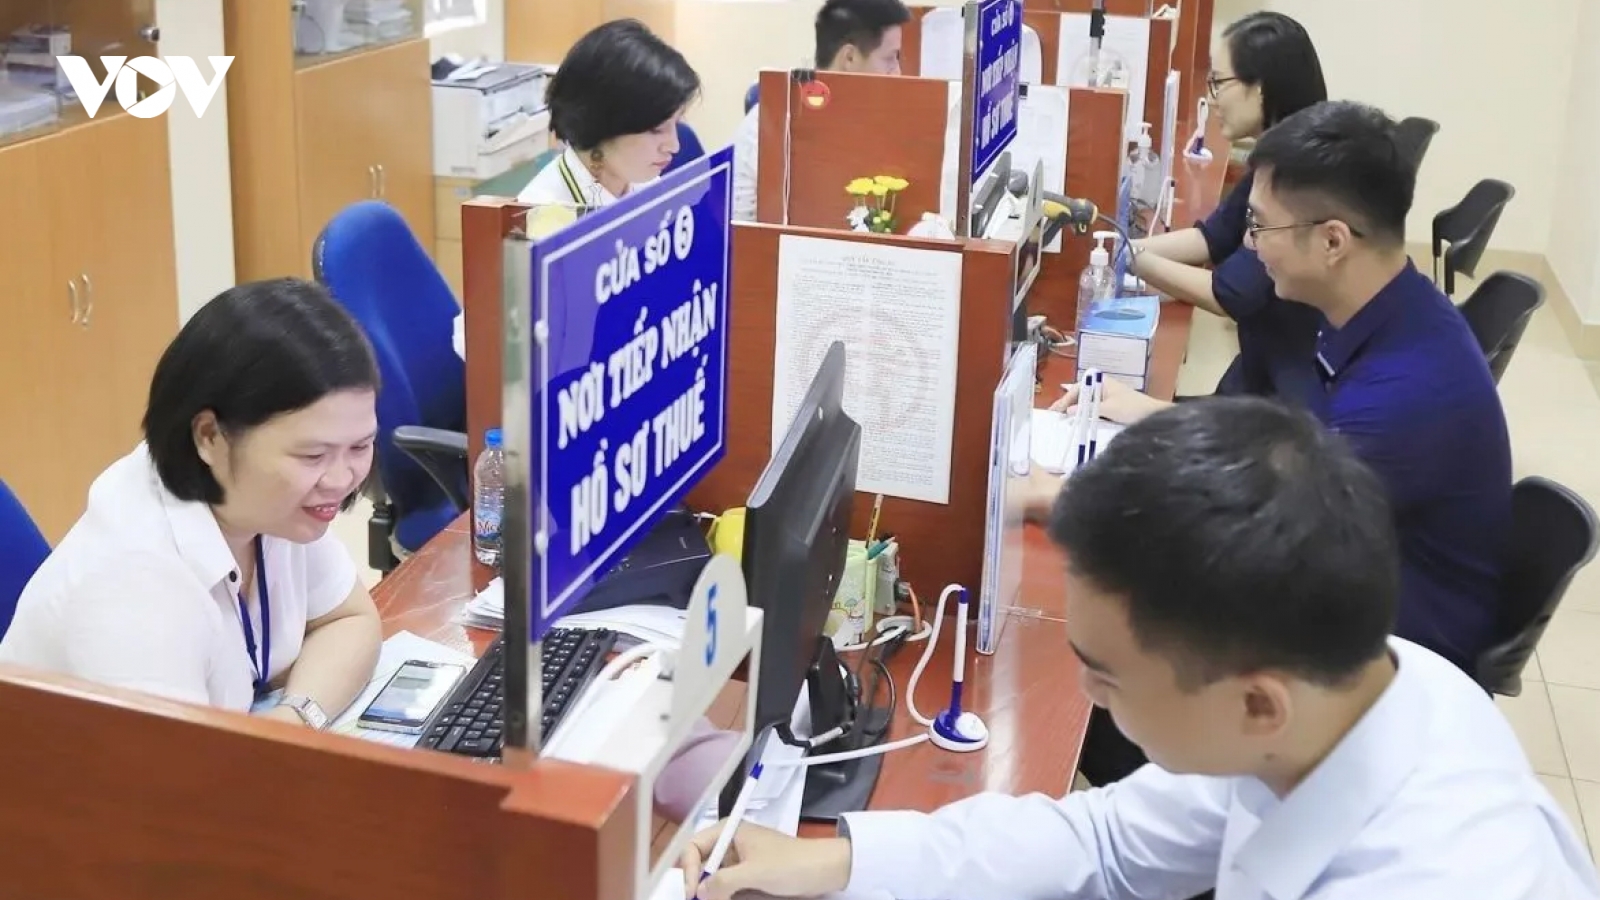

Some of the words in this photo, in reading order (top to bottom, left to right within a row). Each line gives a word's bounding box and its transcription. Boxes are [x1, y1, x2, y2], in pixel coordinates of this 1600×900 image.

[595, 238, 640, 304] CỬA
[557, 361, 605, 450] NƠI
[608, 305, 659, 408] TIẾP
[661, 278, 717, 370] NHẬN
[571, 438, 608, 556] HỒ
[614, 420, 649, 513] SƠ
[653, 354, 708, 477] THUẾ
[705, 582, 718, 667] 5
